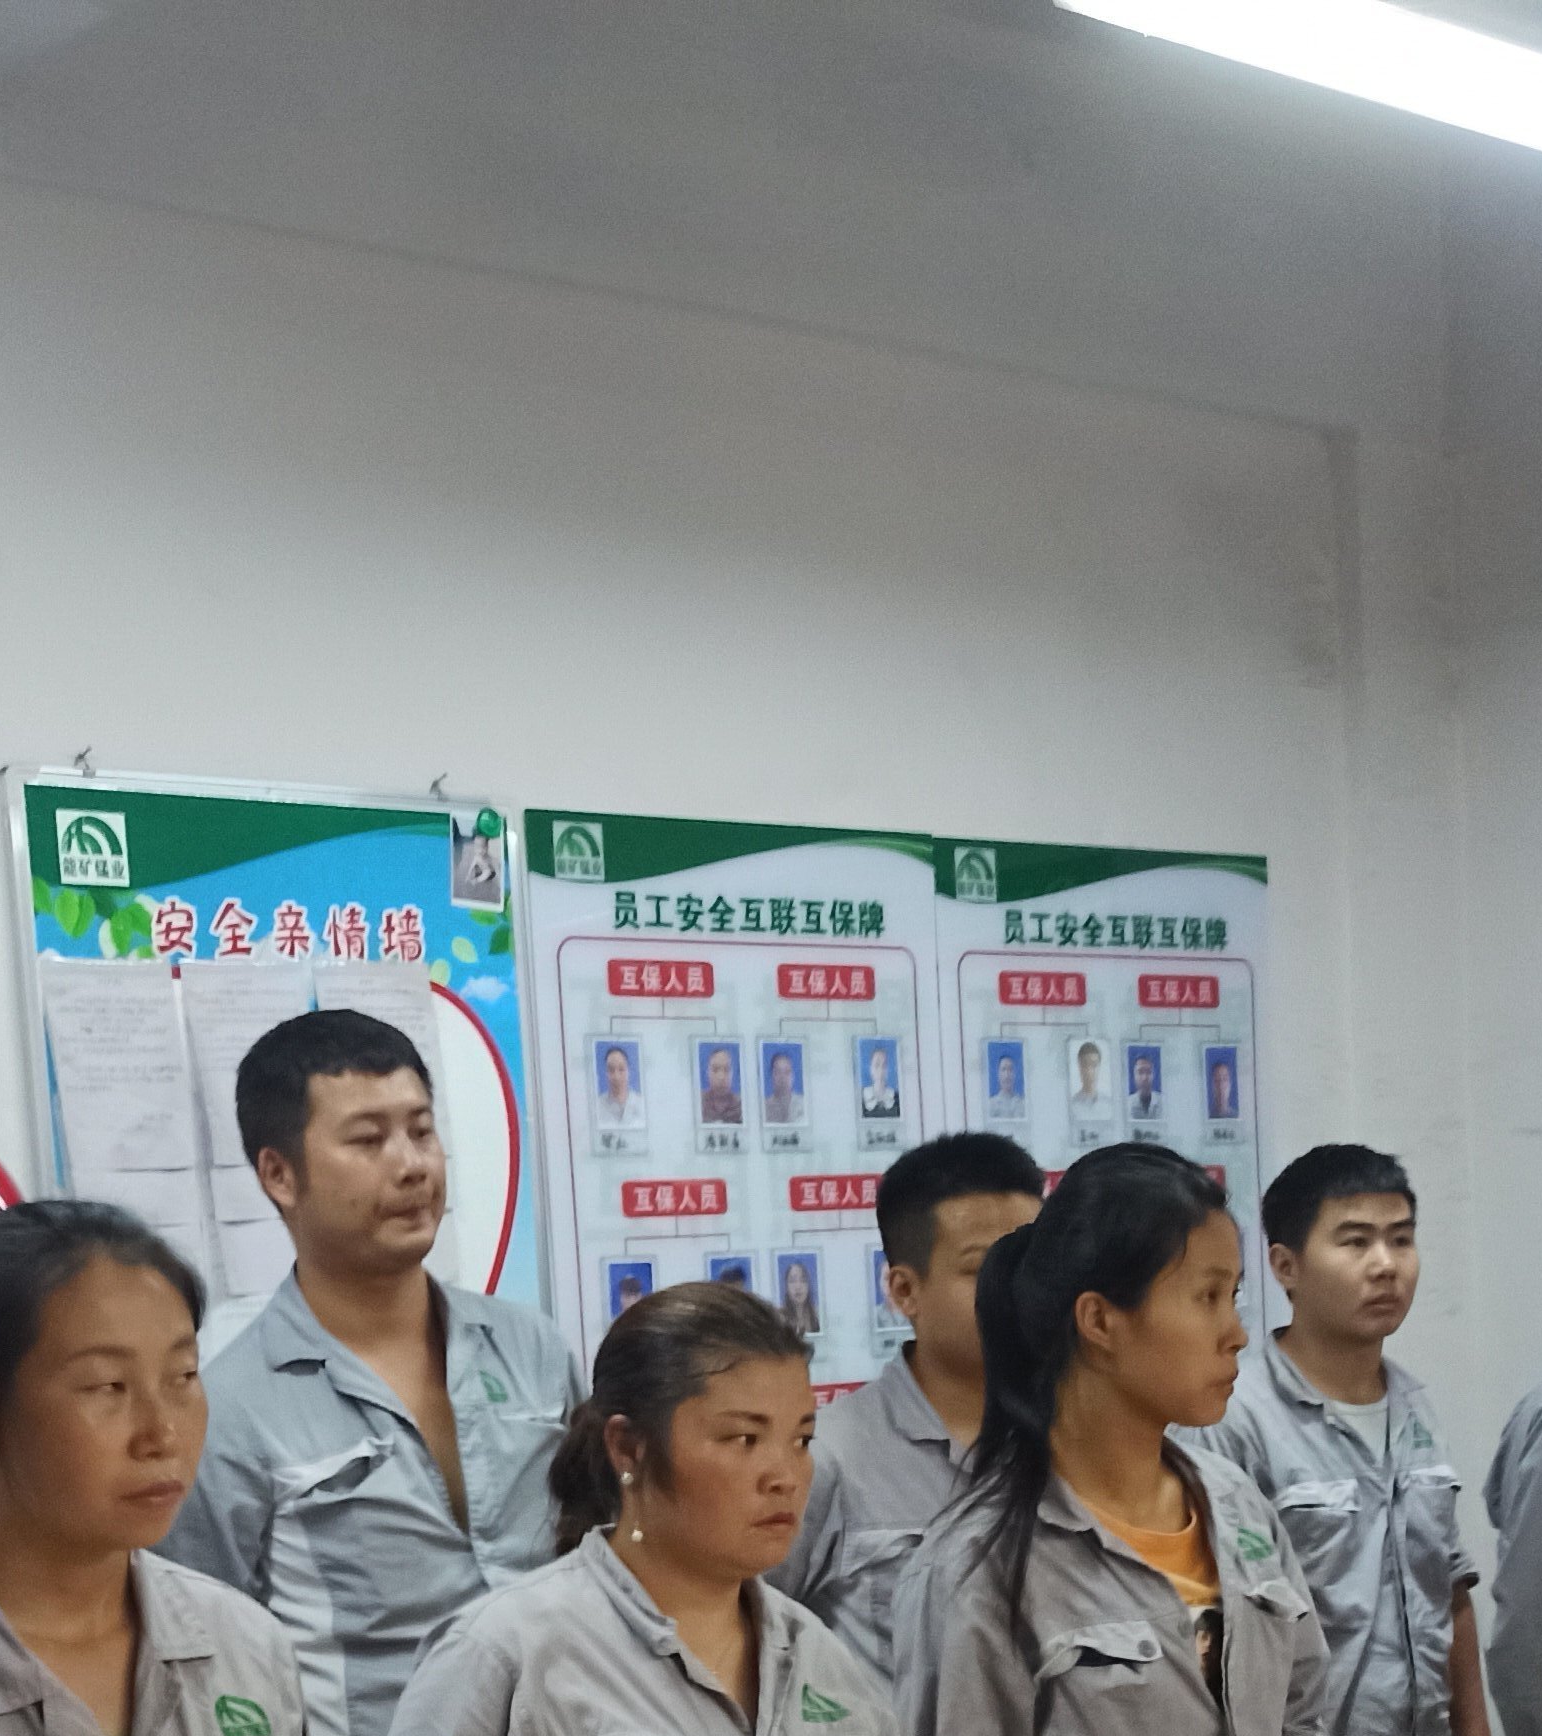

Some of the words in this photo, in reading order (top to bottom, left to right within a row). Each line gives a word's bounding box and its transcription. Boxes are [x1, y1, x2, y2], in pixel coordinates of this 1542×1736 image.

[63, 857, 126, 879] 能矿锰业
[613, 891, 885, 938] 员工安全互联互保牌
[155, 899, 425, 963] 安全亲情墙
[1004, 908, 1228, 951] 员工安全互联互保牌
[619, 965, 706, 993] 互保人员
[788, 969, 867, 996] 互保人员
[1008, 976, 1081, 1002] 互保人员
[1147, 979, 1210, 1003] 互保人员
[632, 1184, 720, 1213] 互保人员
[800, 1178, 878, 1207] 互保人员
